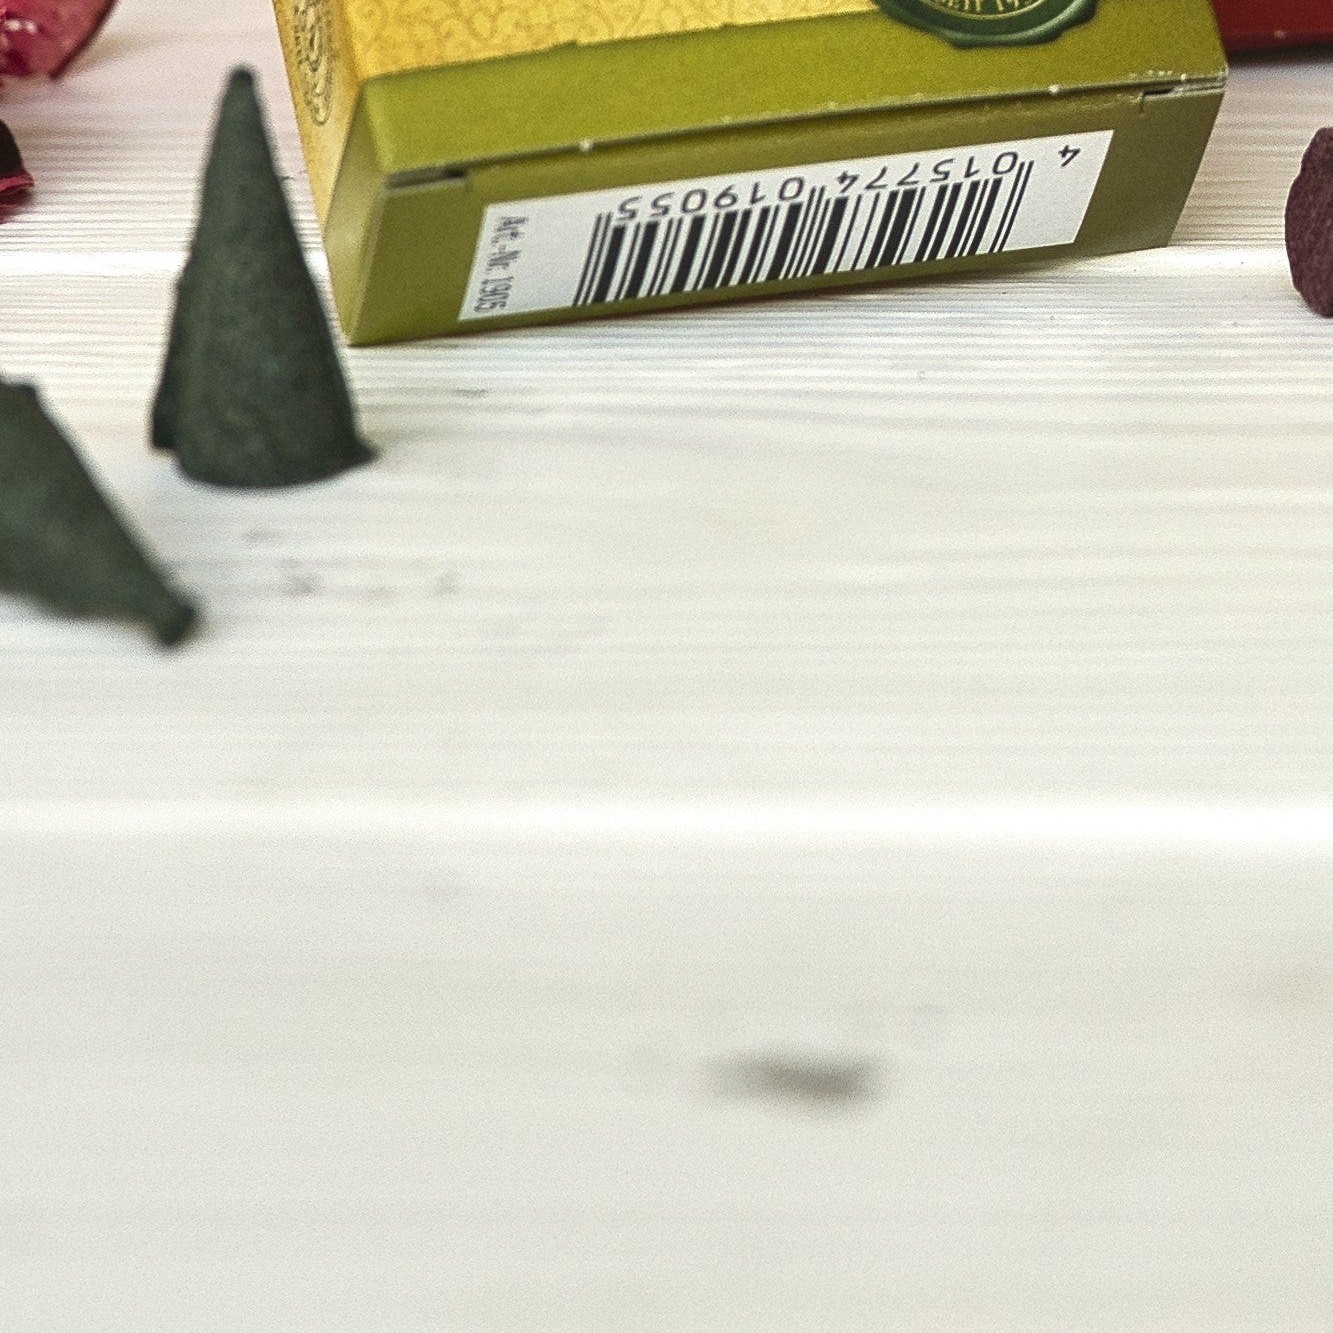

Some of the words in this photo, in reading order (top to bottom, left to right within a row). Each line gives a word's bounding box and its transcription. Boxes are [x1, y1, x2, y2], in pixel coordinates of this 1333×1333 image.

[837, 151, 1020, 192] 015774
[1056, 143, 1082, 167] 4
[616, 175, 807, 224] 019055
[472, 275, 515, 313] 1905
